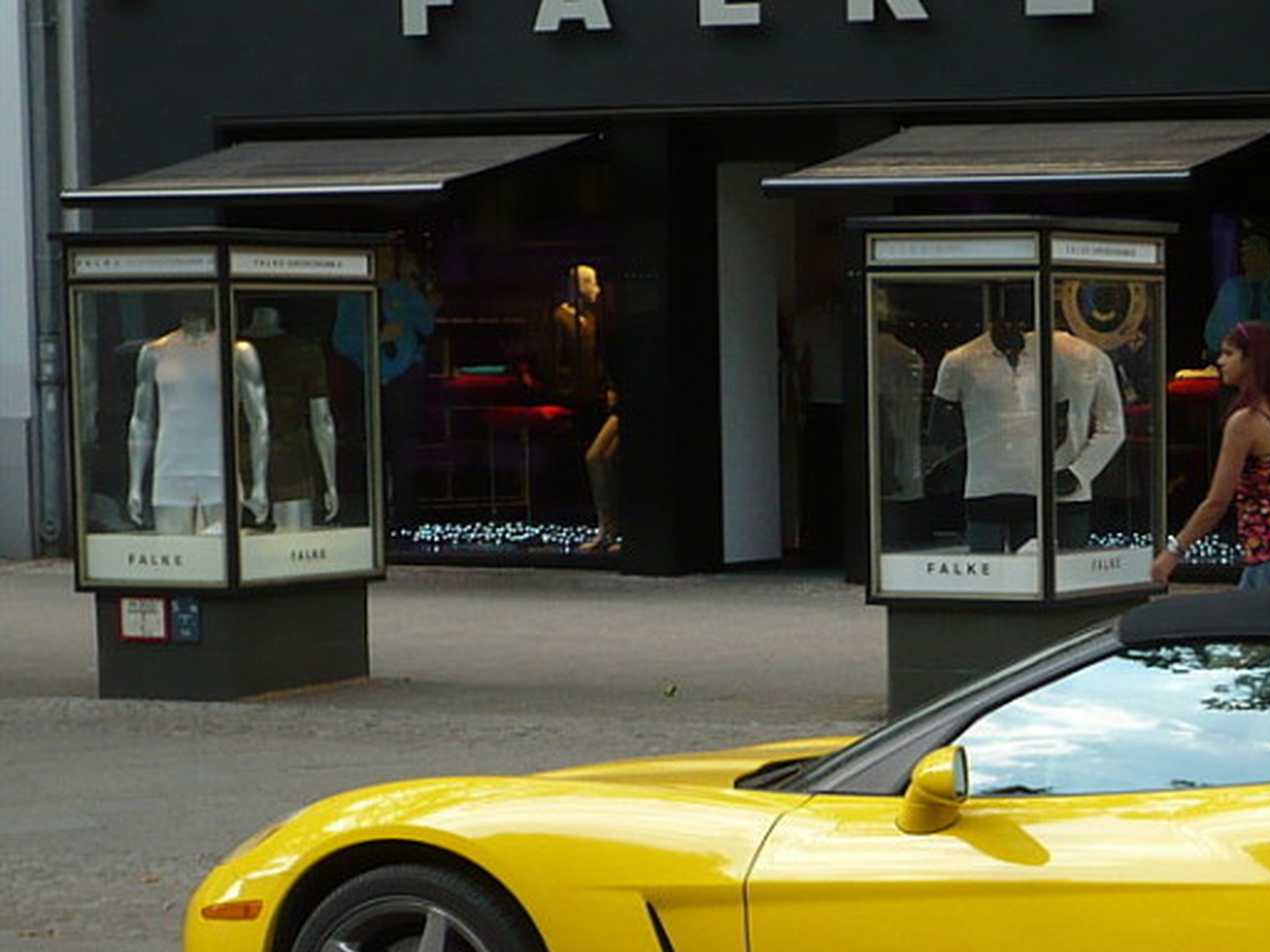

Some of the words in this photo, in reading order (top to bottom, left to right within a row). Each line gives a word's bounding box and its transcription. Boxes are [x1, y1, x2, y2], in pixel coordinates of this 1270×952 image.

[128, 554, 184, 567] FALKE
[291, 549, 326, 562] FALKE
[926, 562, 991, 577] FALKE
